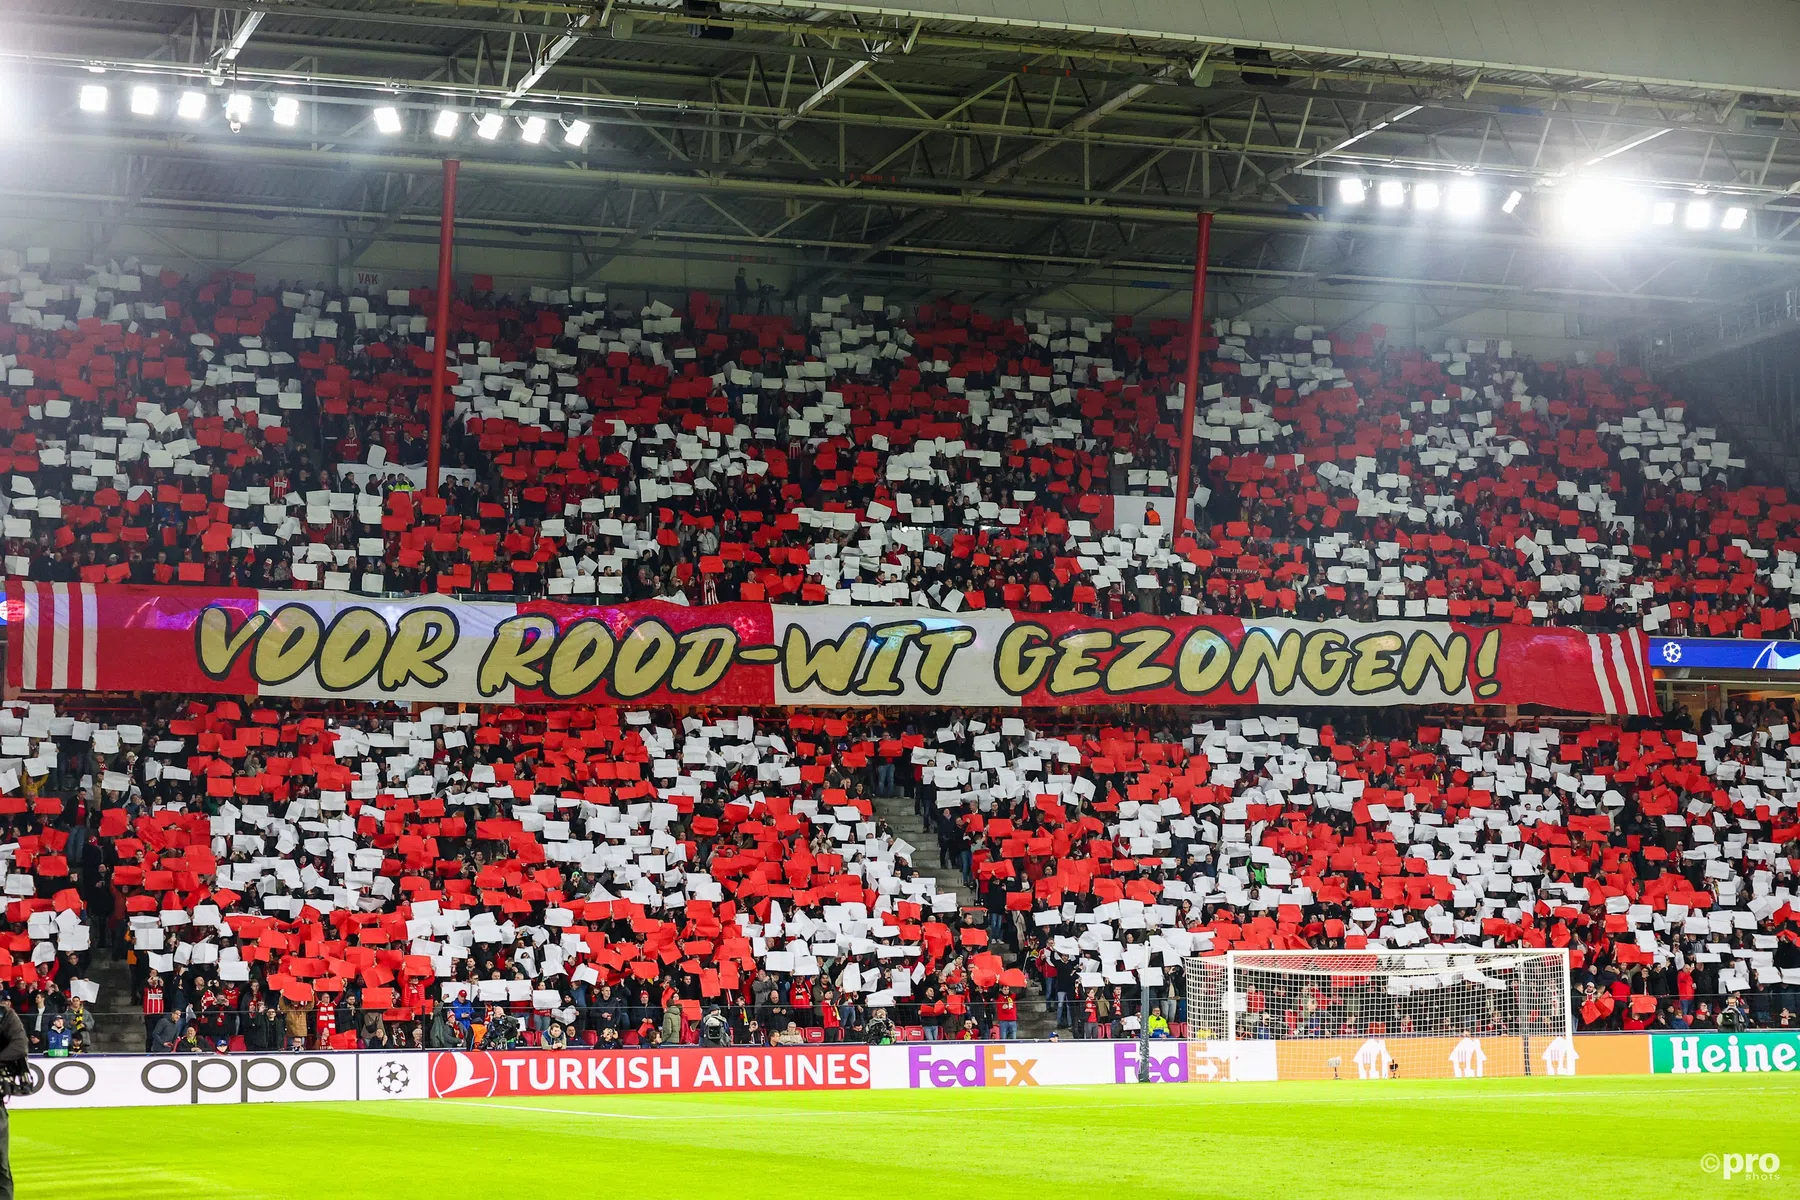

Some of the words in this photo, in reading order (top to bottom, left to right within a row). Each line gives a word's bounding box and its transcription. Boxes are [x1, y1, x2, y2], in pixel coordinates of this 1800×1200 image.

[358, 272, 379, 285] VAK
[195, 603, 460, 692] VOOR
[476, 610, 977, 698] ROOD-WIT
[994, 620, 1502, 698] GEZONGEN!
[501, 1056, 680, 1091] TURKISH
[694, 1053, 870, 1088] AIRLINES
[908, 1044, 1040, 1088] FedEx
[1669, 1035, 1800, 1073] Heine
[141, 1057, 336, 1104] oppo
